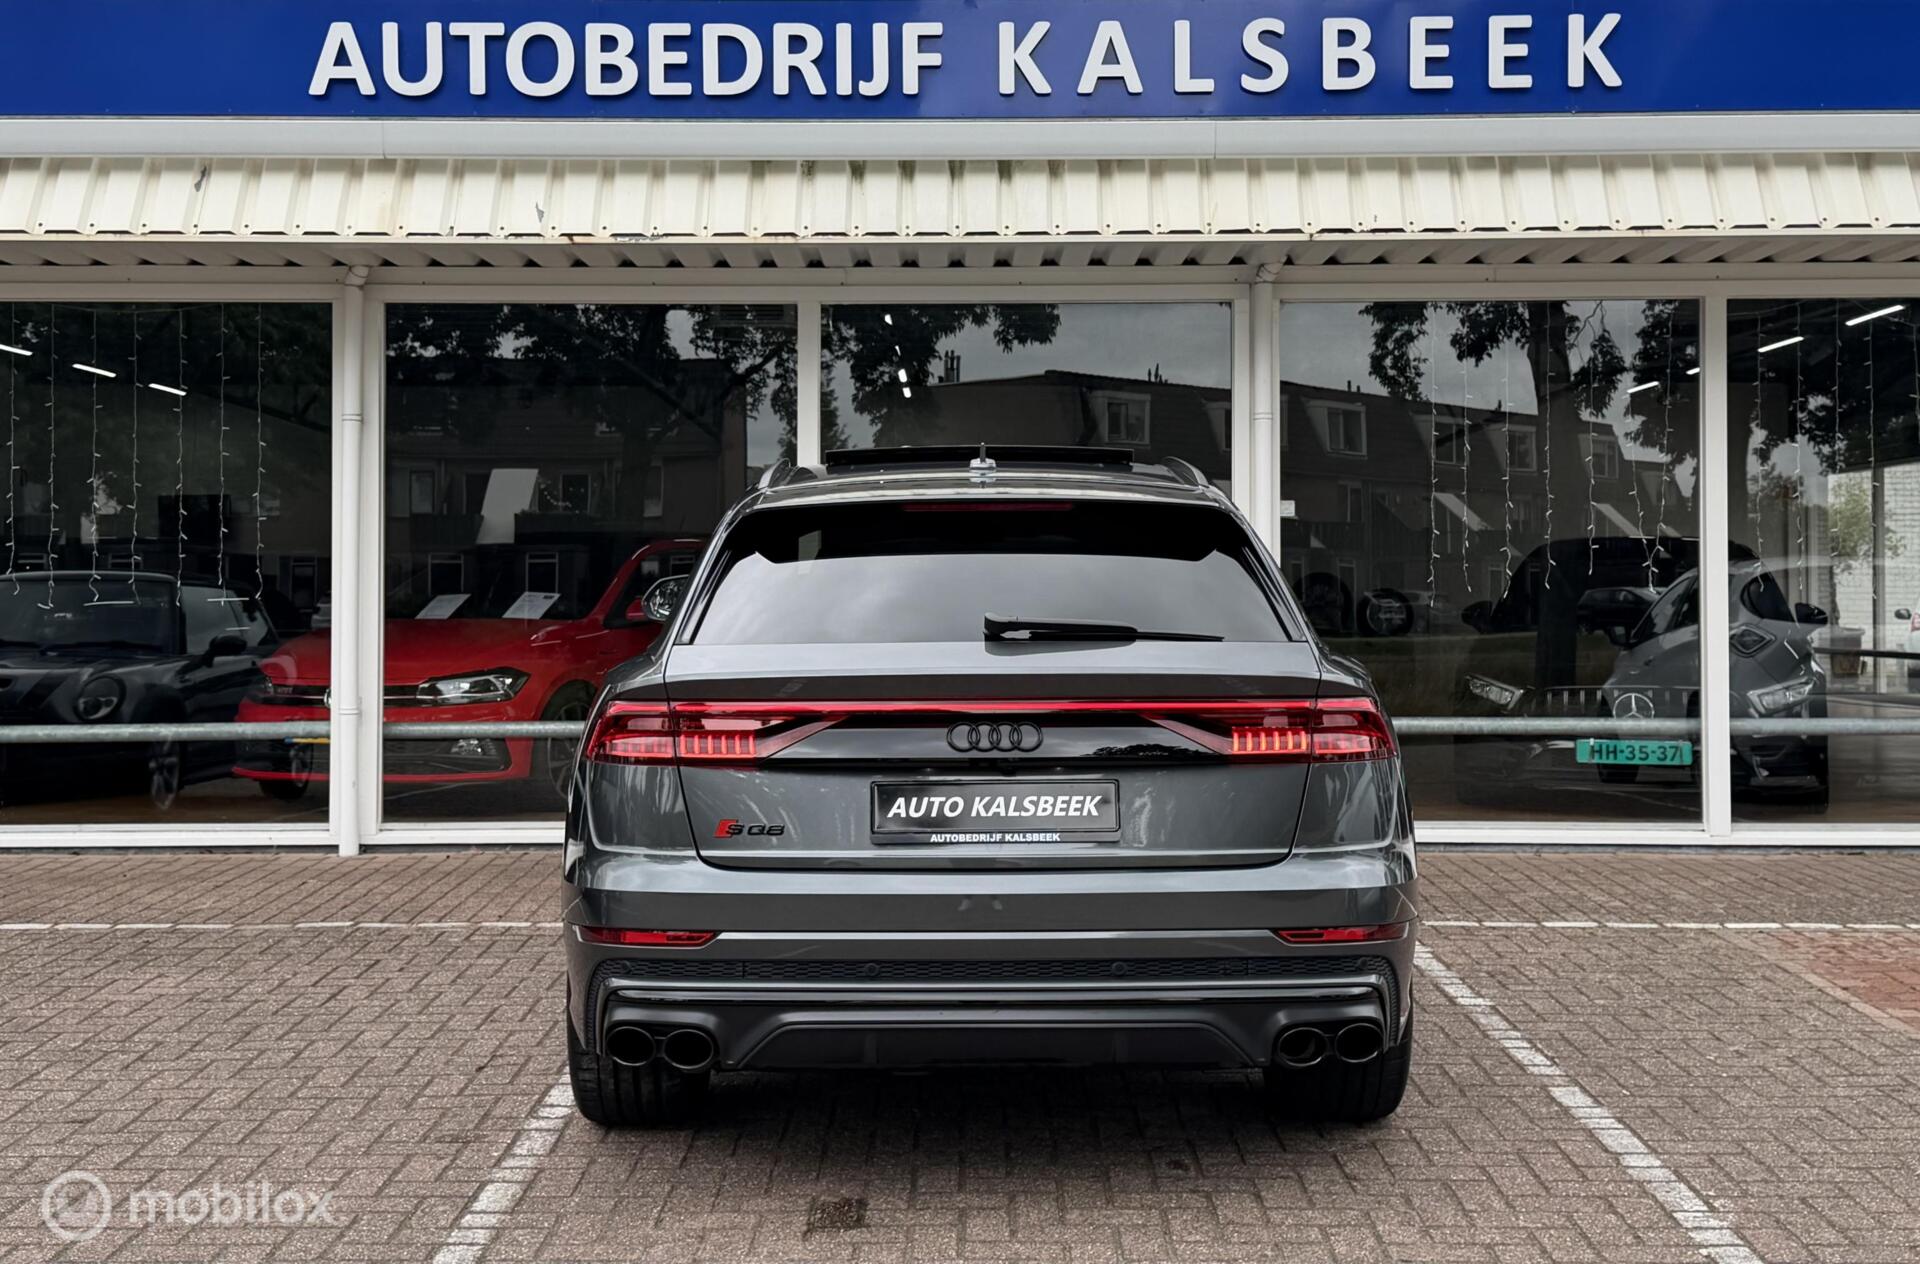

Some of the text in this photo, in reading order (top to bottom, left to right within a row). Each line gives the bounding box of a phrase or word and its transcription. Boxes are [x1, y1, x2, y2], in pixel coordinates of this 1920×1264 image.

[308, 13, 1624, 98] AUTOBEDRIJF KALSBEEK
[1591, 743, 1680, 762] HH-35-37
[887, 795, 1102, 818] AUTO KALSBEEK
[930, 832, 1061, 843] AUTOBEDRIJF KALSBEEK
